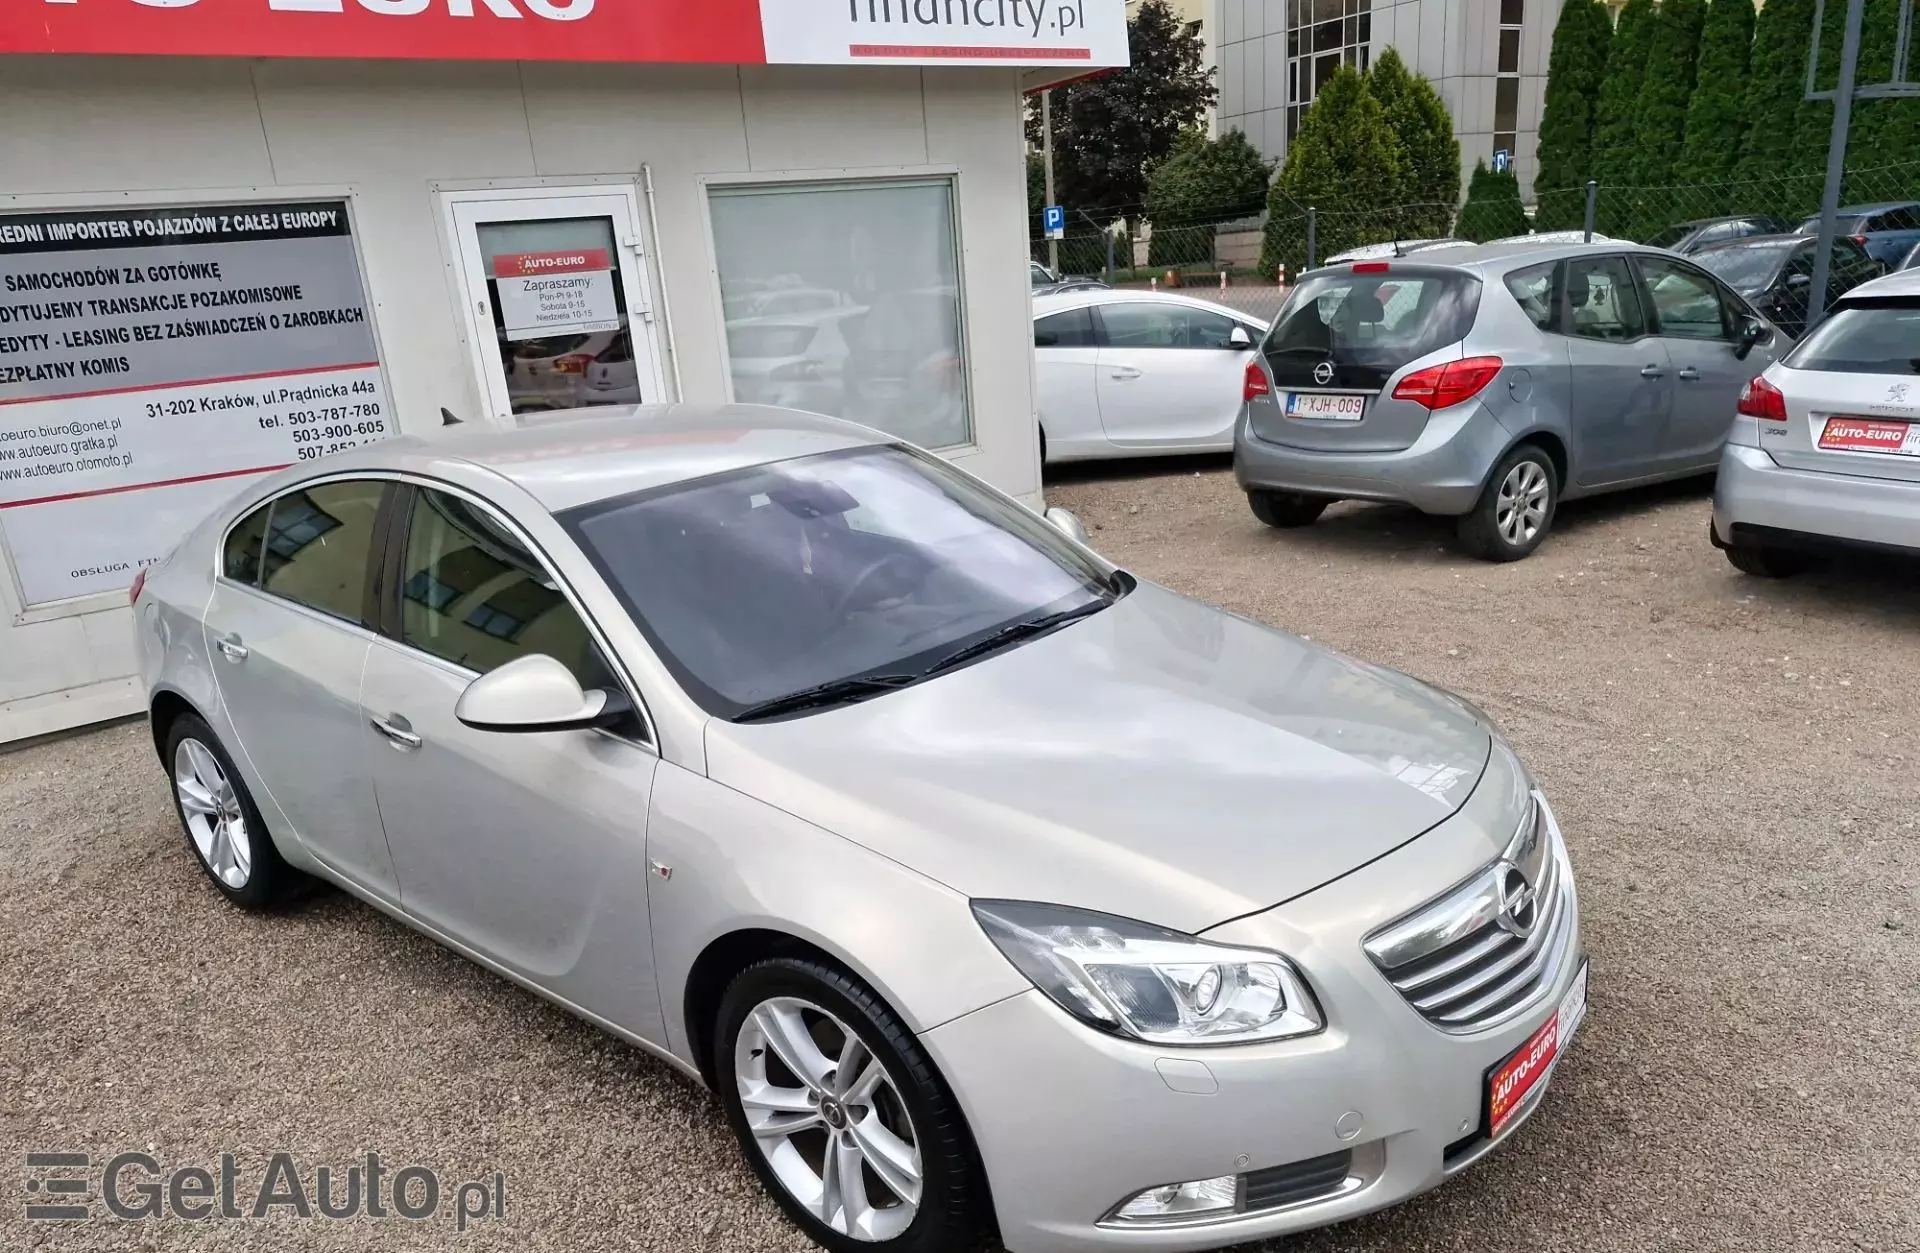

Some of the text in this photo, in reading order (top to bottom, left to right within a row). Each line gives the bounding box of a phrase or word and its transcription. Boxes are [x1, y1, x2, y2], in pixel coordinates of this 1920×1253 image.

[46, 220, 131, 241] IMPORTER
[133, 213, 217, 237] POJAZDÓW
[220, 215, 232, 233] Z
[233, 213, 279, 232] CAŁEJ
[281, 210, 337, 230] EUROPY
[1047, 209, 1060, 227] P
[524, 256, 586, 269] AUTO-EURO
[5, 261, 222, 292] SAMOCHODÓW ZA GOTÓWKĘ
[523, 278, 594, 292] Zapraszamy:
[88, 293, 188, 317] TRANSAKCJE
[190, 285, 303, 308] POZAKOMISOWE
[566, 290, 583, 299] 9-18
[536, 310, 593, 321] Niedziela 10-15
[541, 300, 585, 312] Sobota 9-15
[62, 327, 130, 348] LEASING
[134, 324, 163, 343] BEZ
[167, 312, 267, 339] ZAŚWIADCZEŃ
[269, 314, 280, 330] O
[282, 307, 364, 328] ZAROBKACH
[80, 356, 130, 376] KOMIS
[146, 380, 376, 419] 31-202 Kraków, ul.Prądnicka 44a
[258, 403, 380, 430] tel. 503-787-780
[293, 420, 385, 443] 503-900-605
[1830, 427, 1902, 442] AUTO-EURO
[71, 563, 130, 578] OBSŁUGA
[1496, 1025, 1557, 1104] AUTO-EURO
